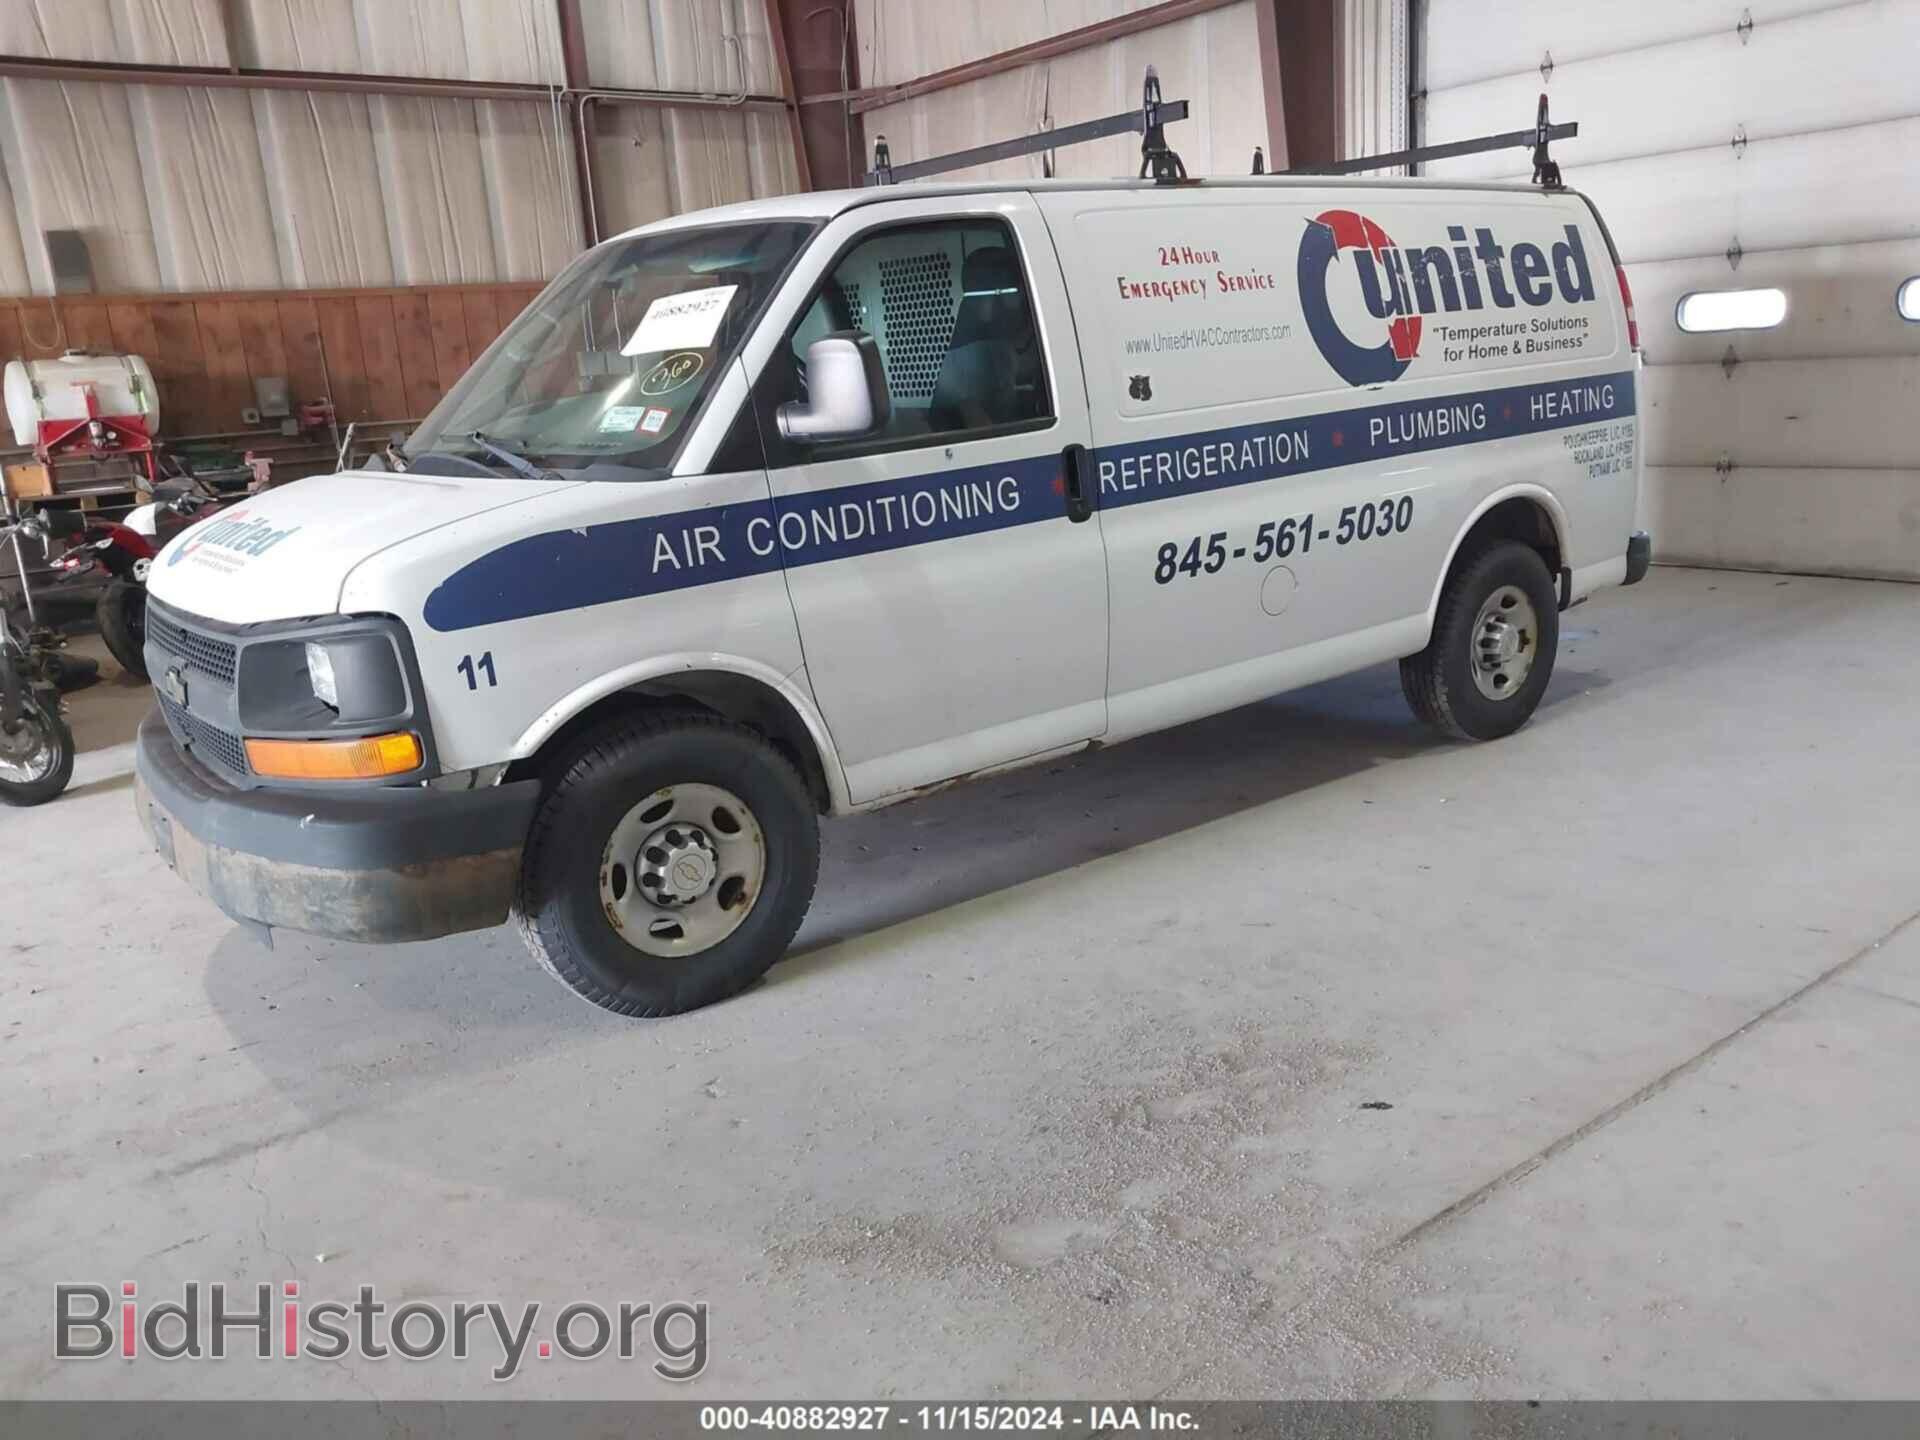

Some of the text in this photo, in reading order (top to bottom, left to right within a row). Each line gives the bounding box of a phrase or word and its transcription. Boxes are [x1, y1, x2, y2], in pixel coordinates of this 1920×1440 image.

[1159, 247, 1179, 266] 24
[1353, 225, 1596, 318] united
[1125, 324, 1292, 354] www.UnitedHVACContractors.com
[1531, 316, 1588, 333] Solutions
[1444, 350, 1465, 362] for
[1469, 343, 1507, 358] Home
[1512, 342, 1522, 354] &
[1530, 384, 1615, 421] HEATING
[1370, 403, 1487, 446] PLUMBING
[1100, 431, 1310, 494] REFRIGERATION
[651, 476, 1021, 574] AIR CONDITIONING
[457, 651, 498, 690] 11
